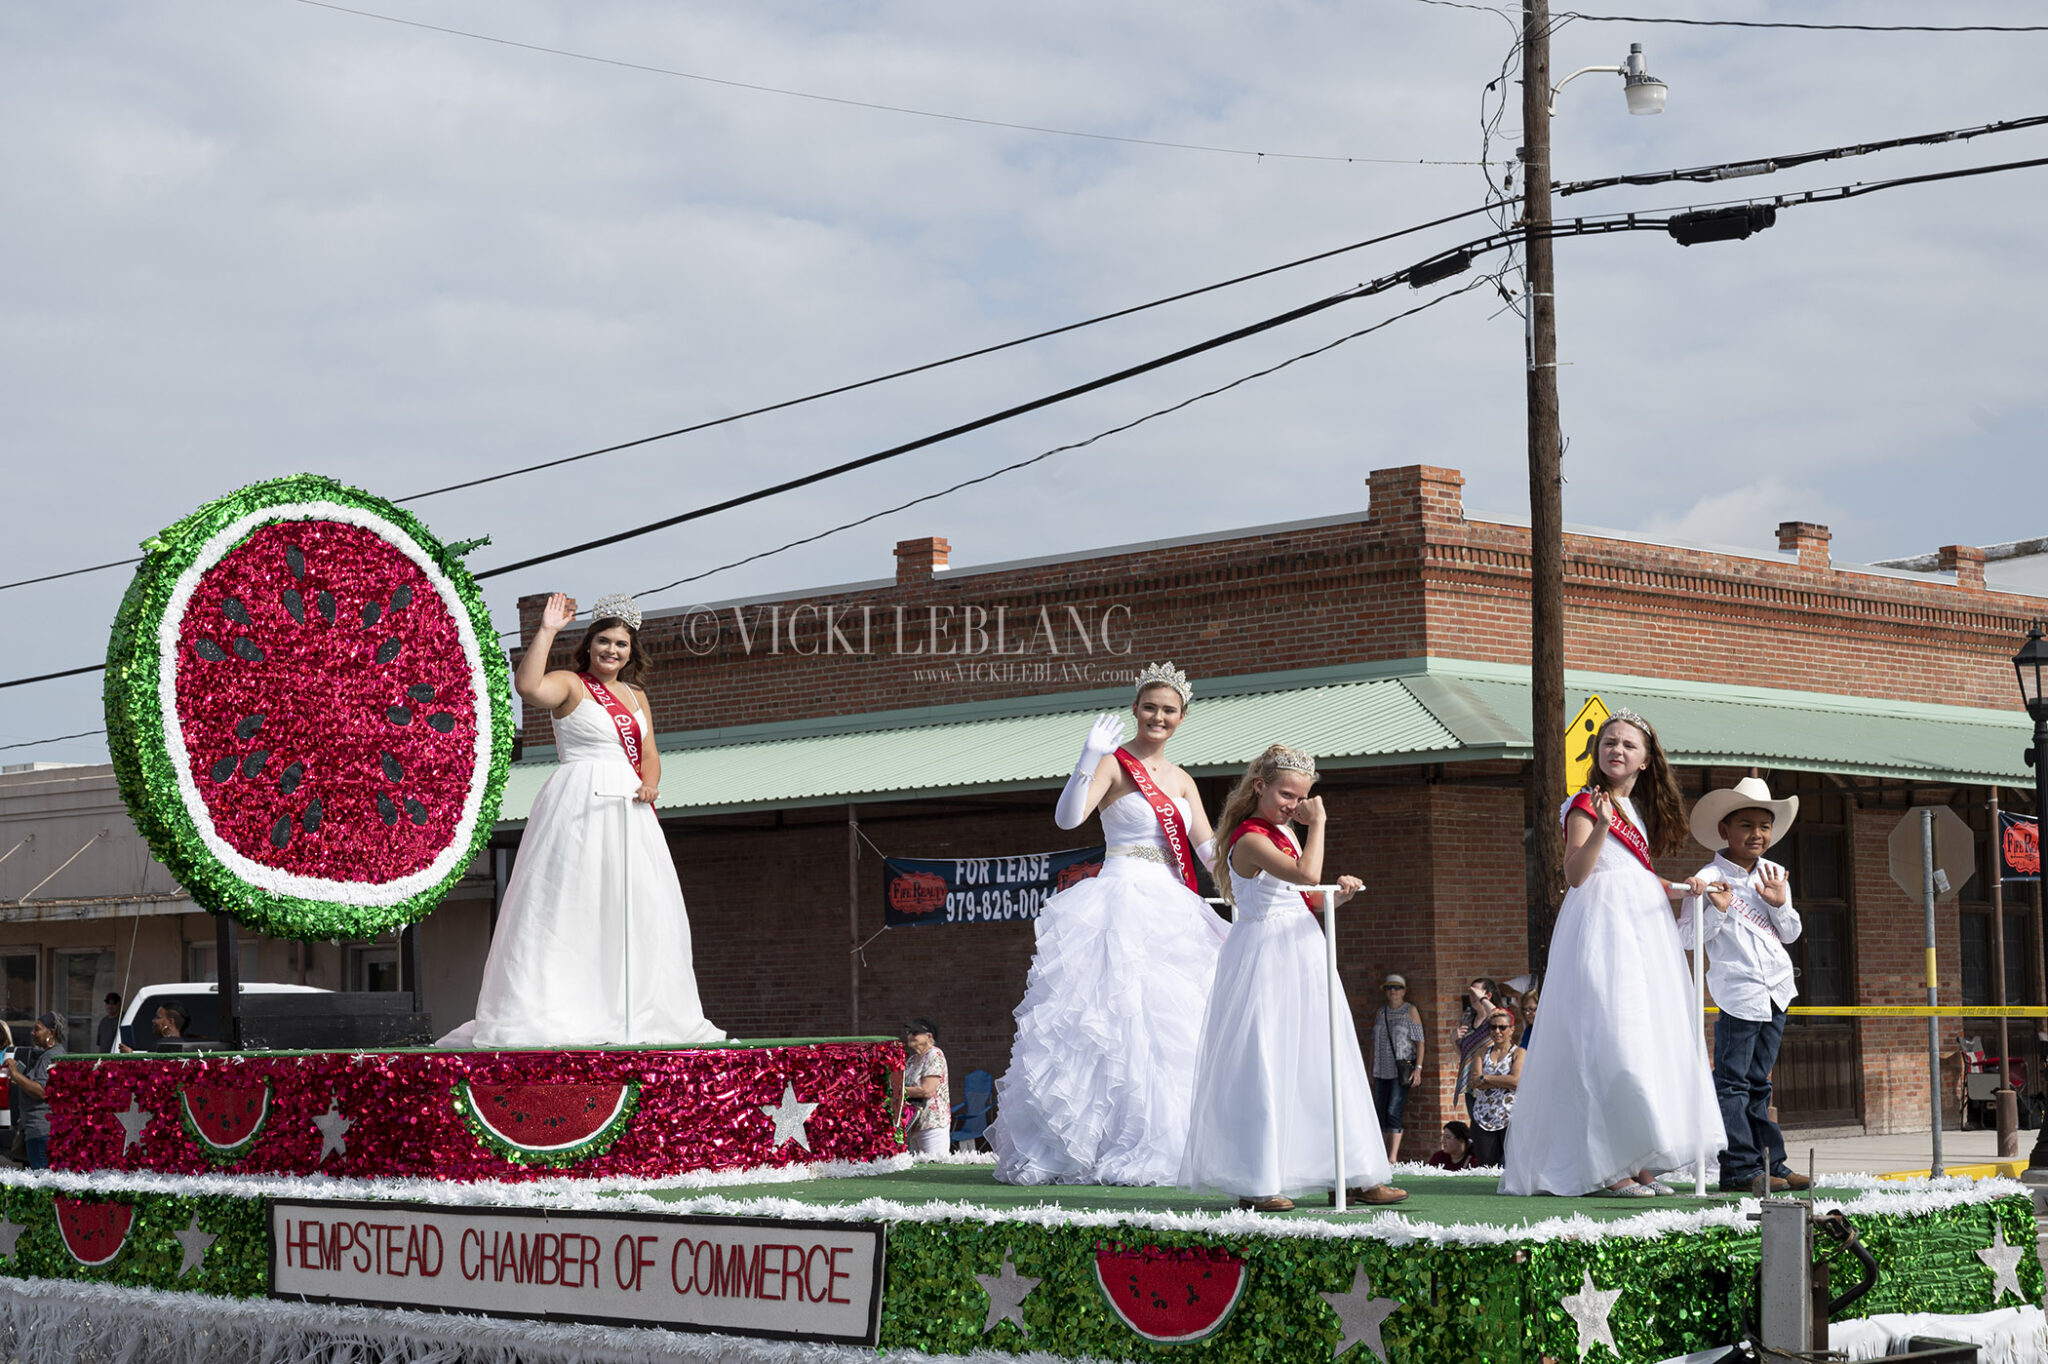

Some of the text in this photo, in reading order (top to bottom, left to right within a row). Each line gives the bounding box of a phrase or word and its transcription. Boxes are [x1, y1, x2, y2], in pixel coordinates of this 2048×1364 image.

[589, 682, 640, 765] 2021 Queen
[1131, 769, 1186, 871] 2021 Princess
[1620, 825, 1641, 848] Little
[955, 860, 990, 886] FOR
[996, 855, 1050, 884] LEASE
[945, 887, 1058, 921] 979-826-001
[286, 1219, 853, 1305] HEMPSTEAD CHAMBER OF COMMERCE
